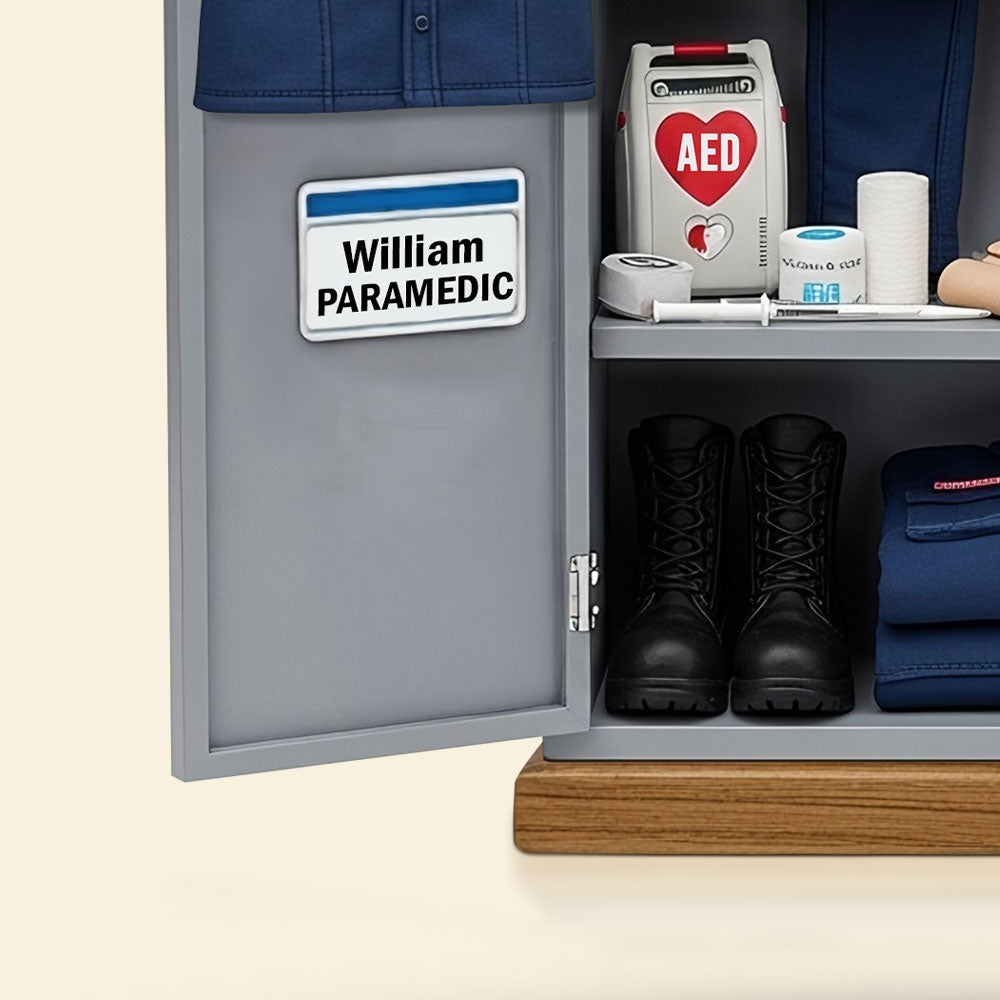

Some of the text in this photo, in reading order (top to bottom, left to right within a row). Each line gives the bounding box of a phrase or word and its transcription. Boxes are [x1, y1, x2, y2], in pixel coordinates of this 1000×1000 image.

[676, 133, 740, 172] AED
[342, 234, 484, 274] William
[317, 271, 514, 317] PARAMEDIC
